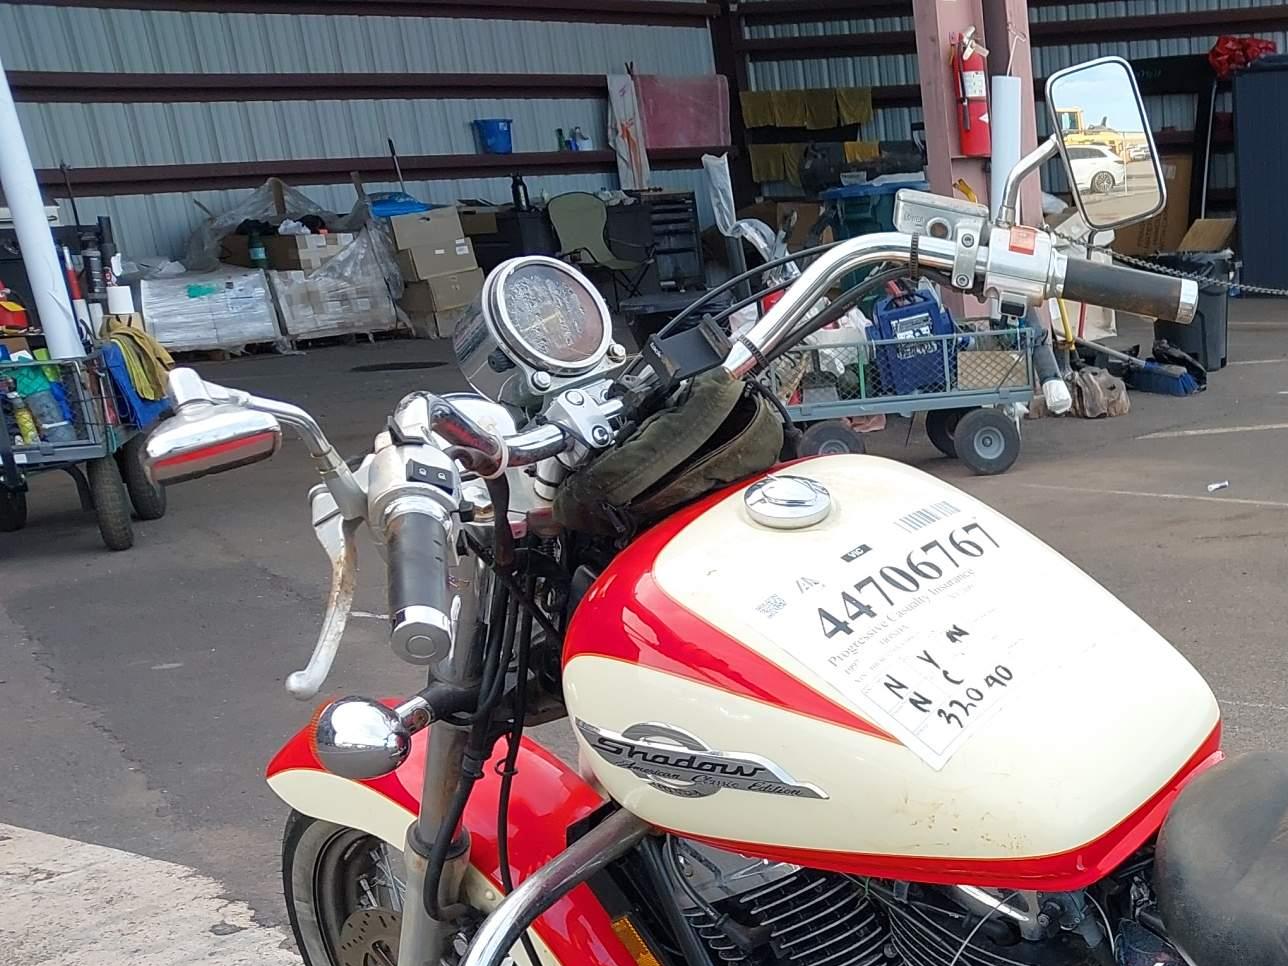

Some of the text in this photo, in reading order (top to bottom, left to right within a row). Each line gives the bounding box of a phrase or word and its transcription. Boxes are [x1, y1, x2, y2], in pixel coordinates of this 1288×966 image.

[816, 522, 1001, 640] 44706767
[827, 620, 889, 668] Progressive
[886, 593, 930, 623] Casualty
[927, 568, 976, 596] Insurance
[884, 674, 908, 699] N
[916, 650, 941, 670] Y
[908, 690, 932, 714] N
[591, 737, 767, 777] Shadow
[615, 760, 802, 796] American Classic Edition
